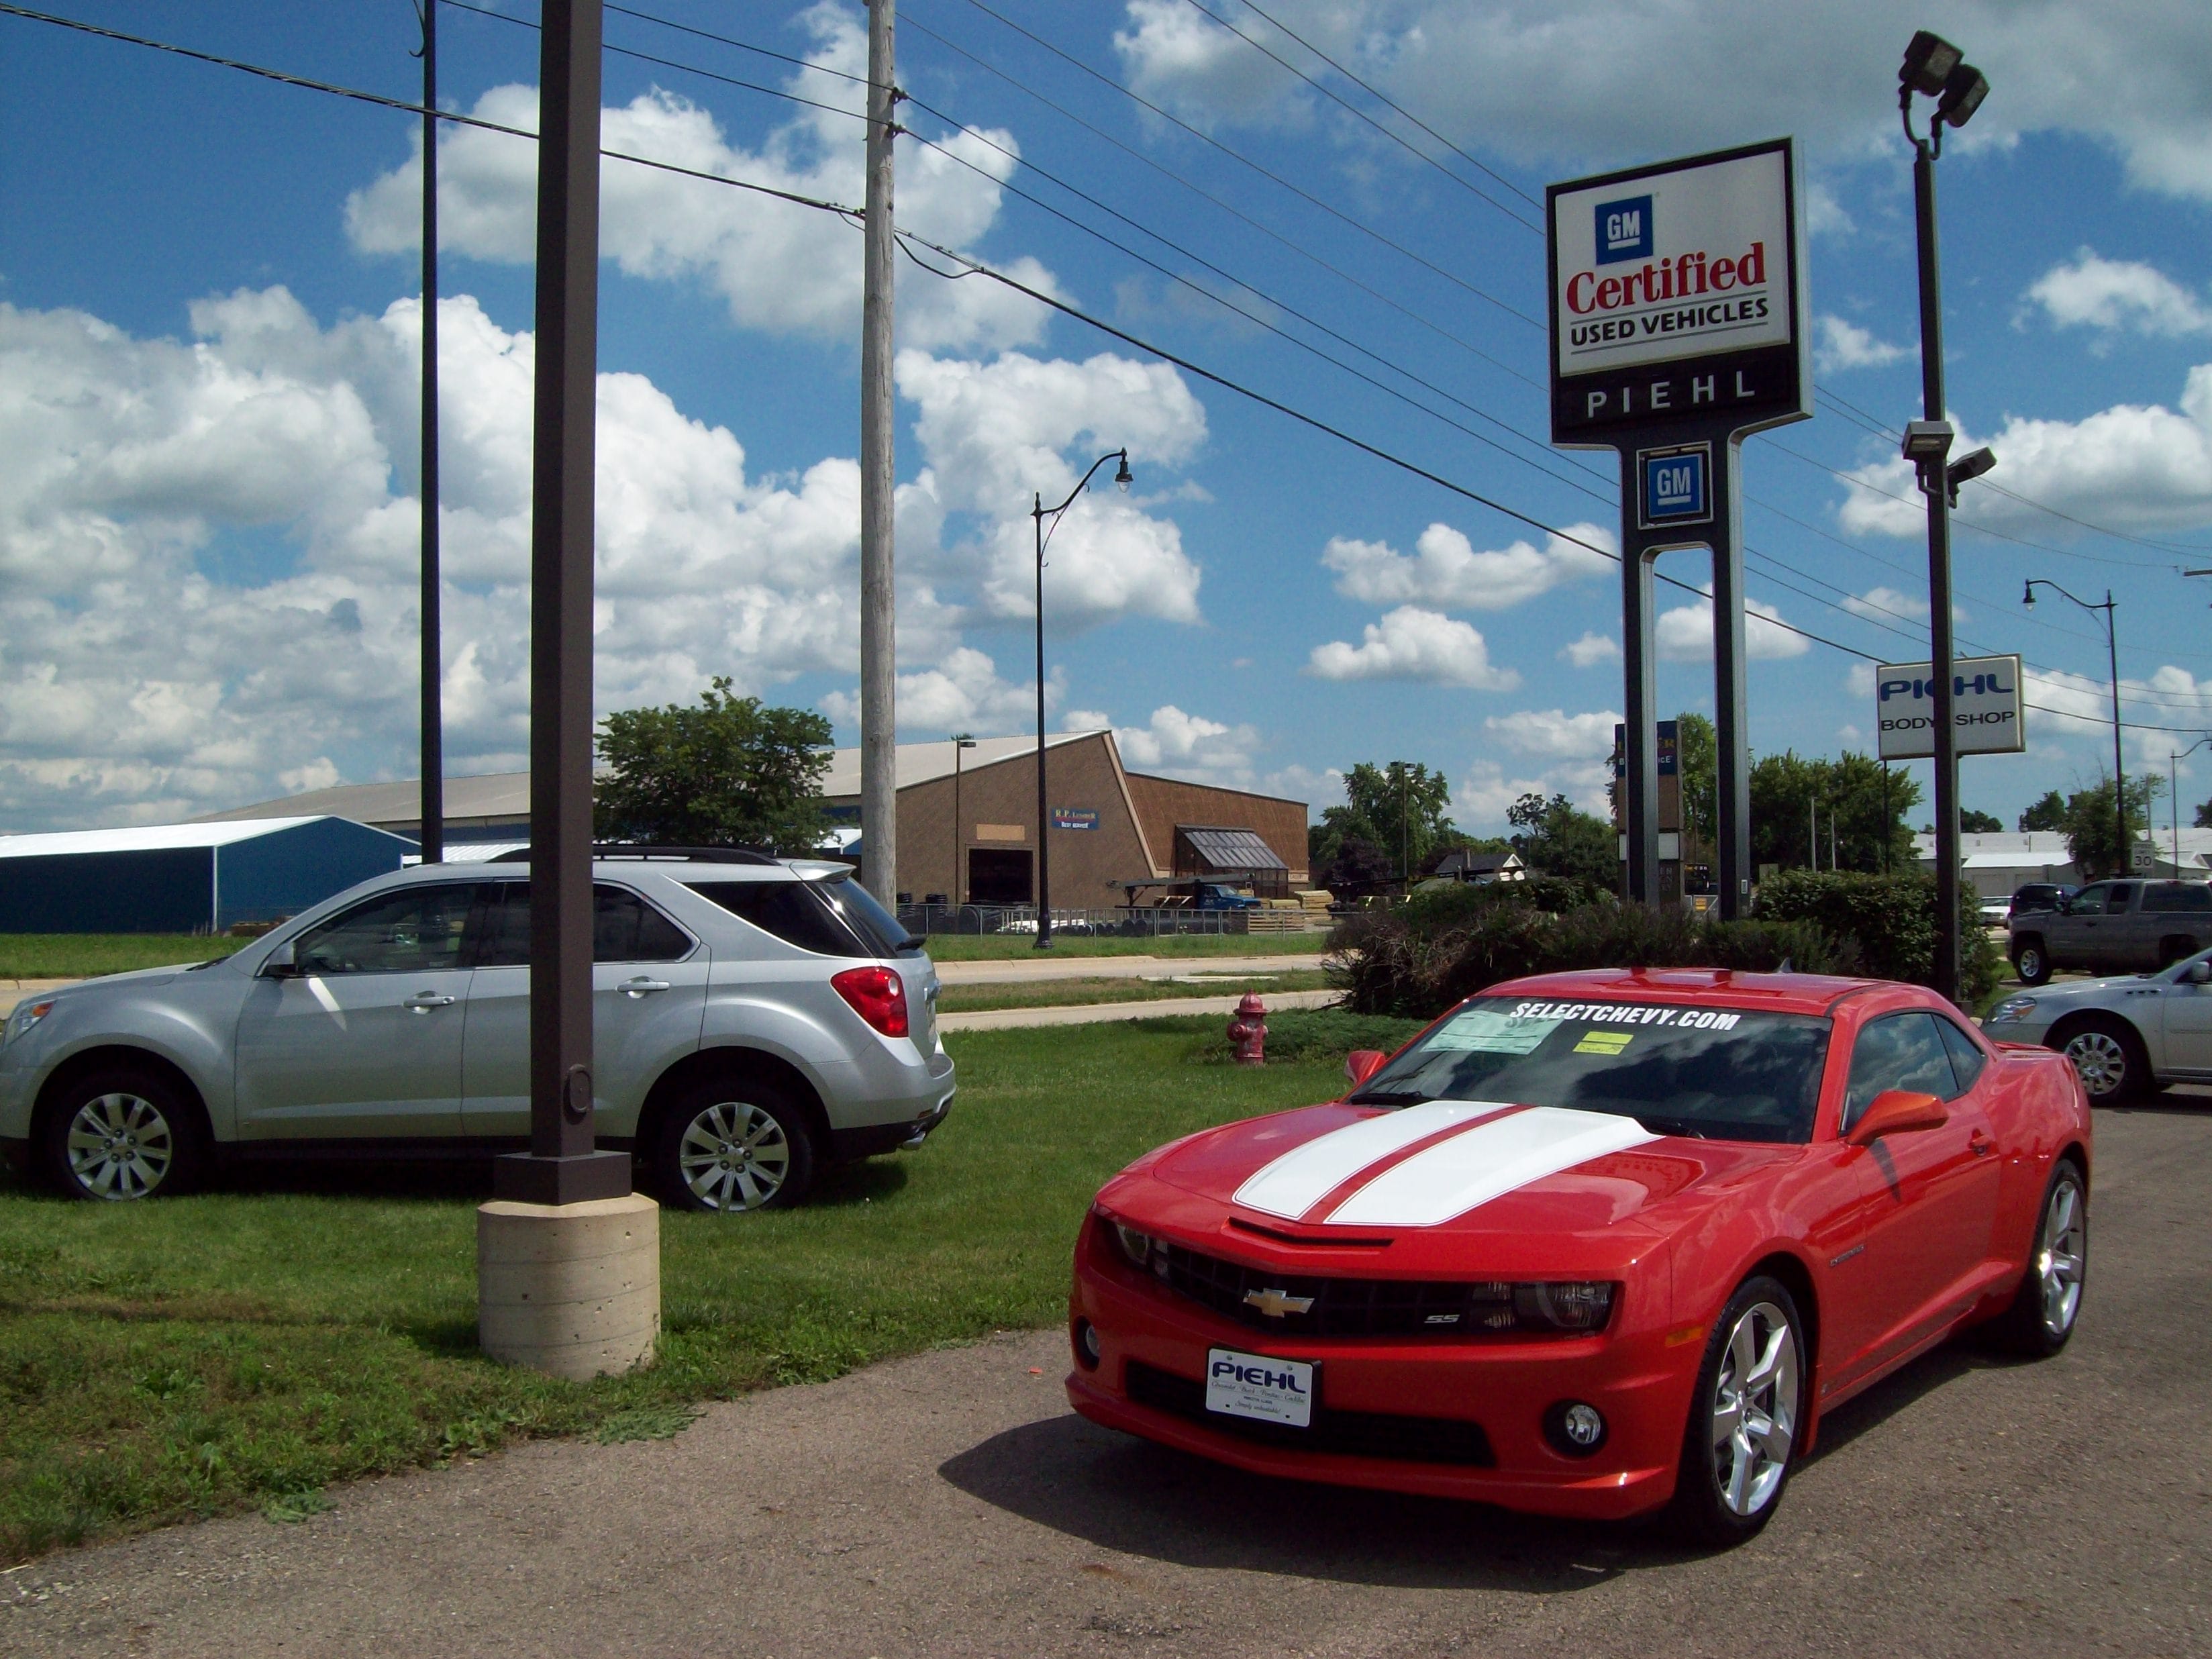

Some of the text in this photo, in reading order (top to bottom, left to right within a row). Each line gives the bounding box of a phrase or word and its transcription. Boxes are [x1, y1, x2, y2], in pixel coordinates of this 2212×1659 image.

[1607, 209, 1640, 241] GM
[1566, 242, 1767, 314] Certified
[1570, 297, 1769, 346] USED VEHICLES
[1587, 370, 1756, 418] PIEHL
[1656, 466, 1691, 497] GM
[1954, 711, 2015, 725] SHOP
[2135, 856, 2152, 866] 30
[1510, 1003, 1742, 1031] SELECTCHEVY.COM
[1423, 1314, 1460, 1323] SS
[1212, 1361, 1307, 1395] PIEHL
